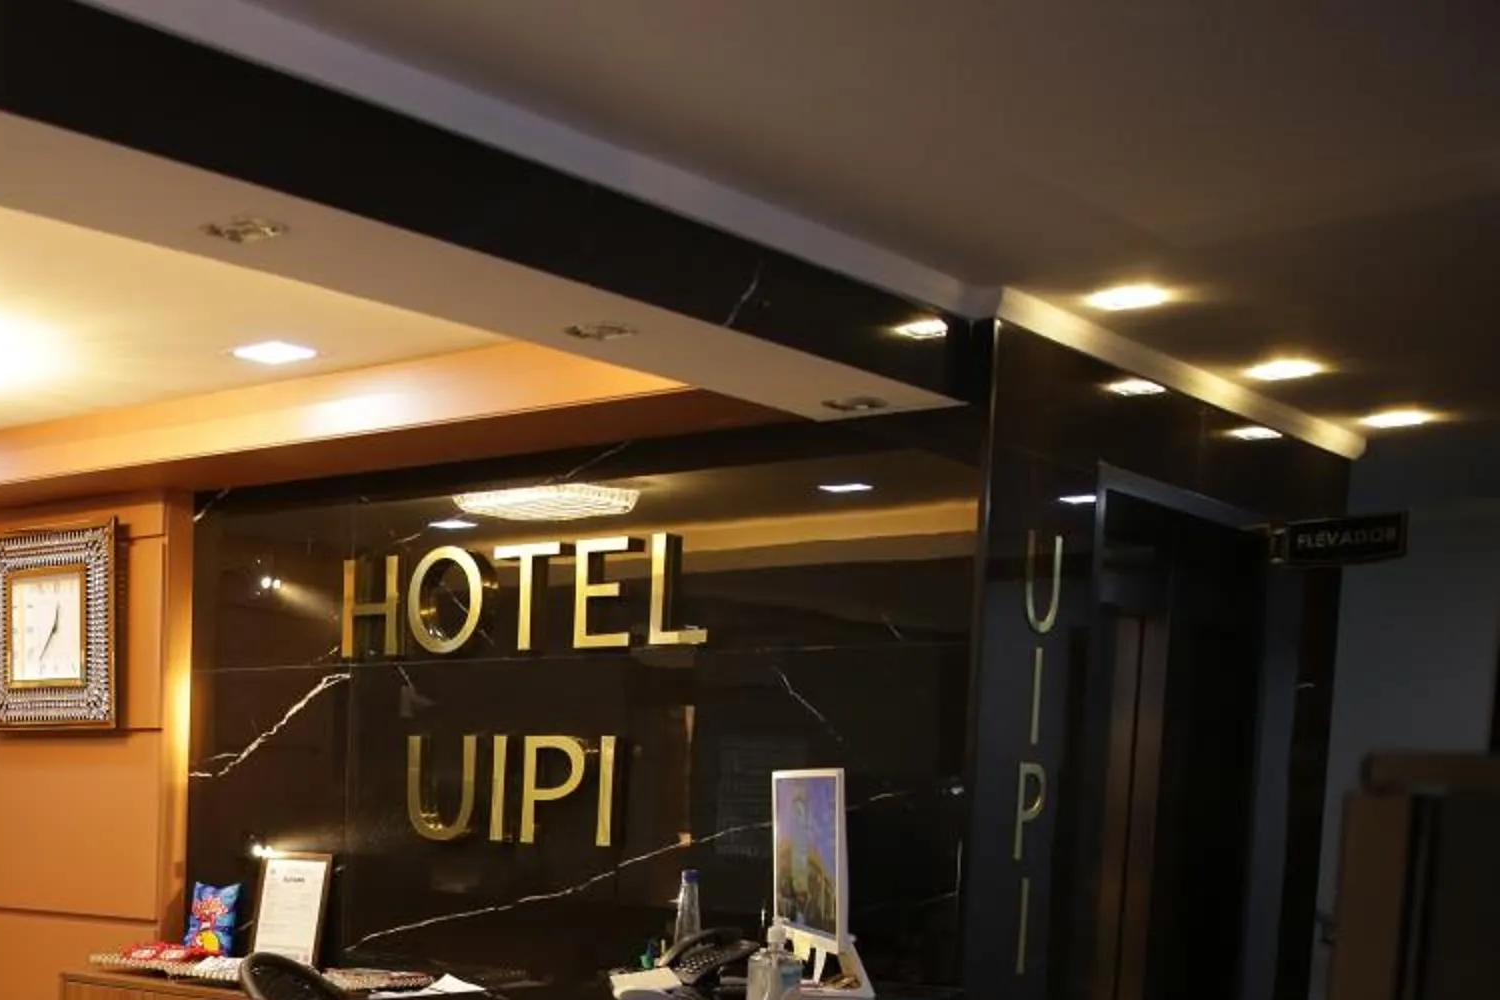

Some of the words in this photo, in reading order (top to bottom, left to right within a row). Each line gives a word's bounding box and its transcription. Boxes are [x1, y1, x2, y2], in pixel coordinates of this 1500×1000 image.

[341, 532, 708, 658] HOTEL
[406, 735, 617, 847] UIPI
[1014, 529, 1064, 975] UIPI
